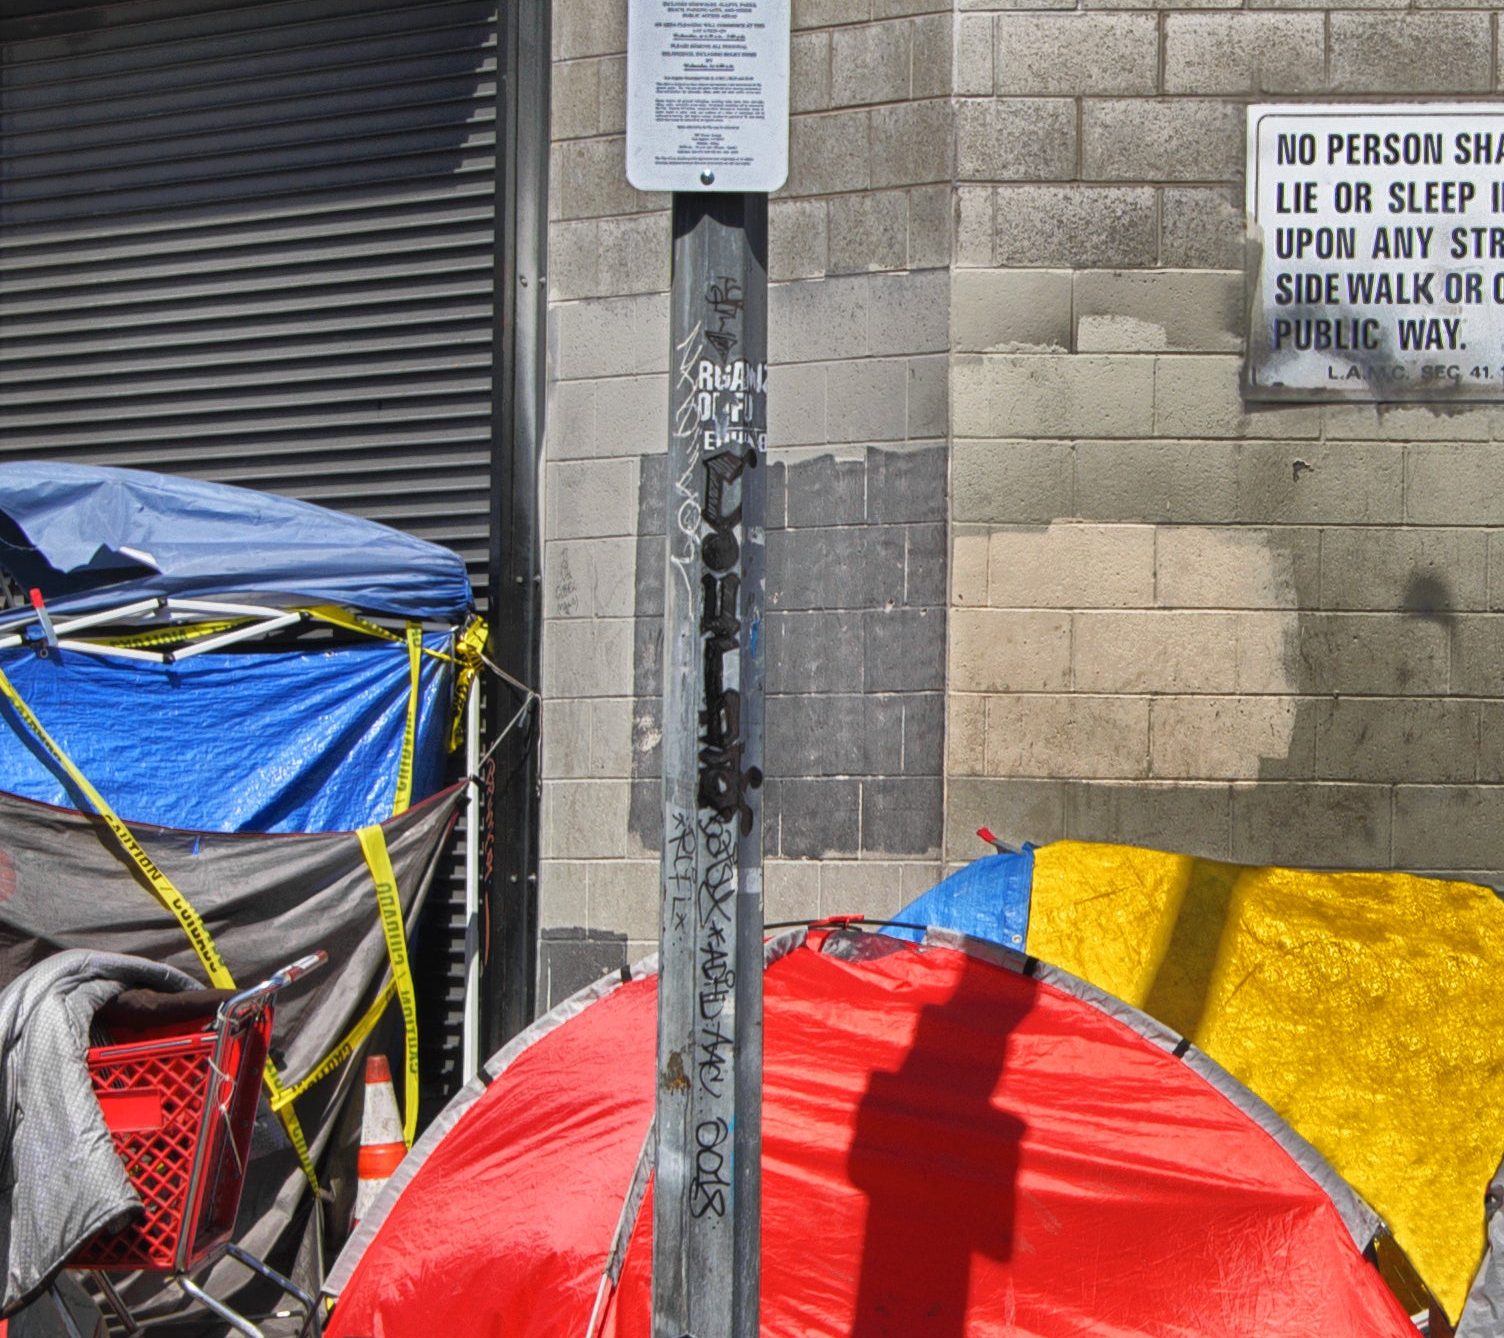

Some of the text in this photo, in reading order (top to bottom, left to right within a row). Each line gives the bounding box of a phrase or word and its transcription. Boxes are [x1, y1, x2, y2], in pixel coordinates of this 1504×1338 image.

[1277, 133, 1316, 165] NO
[1327, 133, 1444, 165] PERSON
[1276, 181, 1319, 214] LIE
[1334, 181, 1372, 214] OR
[1388, 181, 1476, 214] SLEEP
[1275, 227, 1356, 260] UPON
[1371, 227, 1434, 259] ANY
[1444, 272, 1483, 305] OR
[1274, 318, 1467, 352] PUBLIC WAY.
